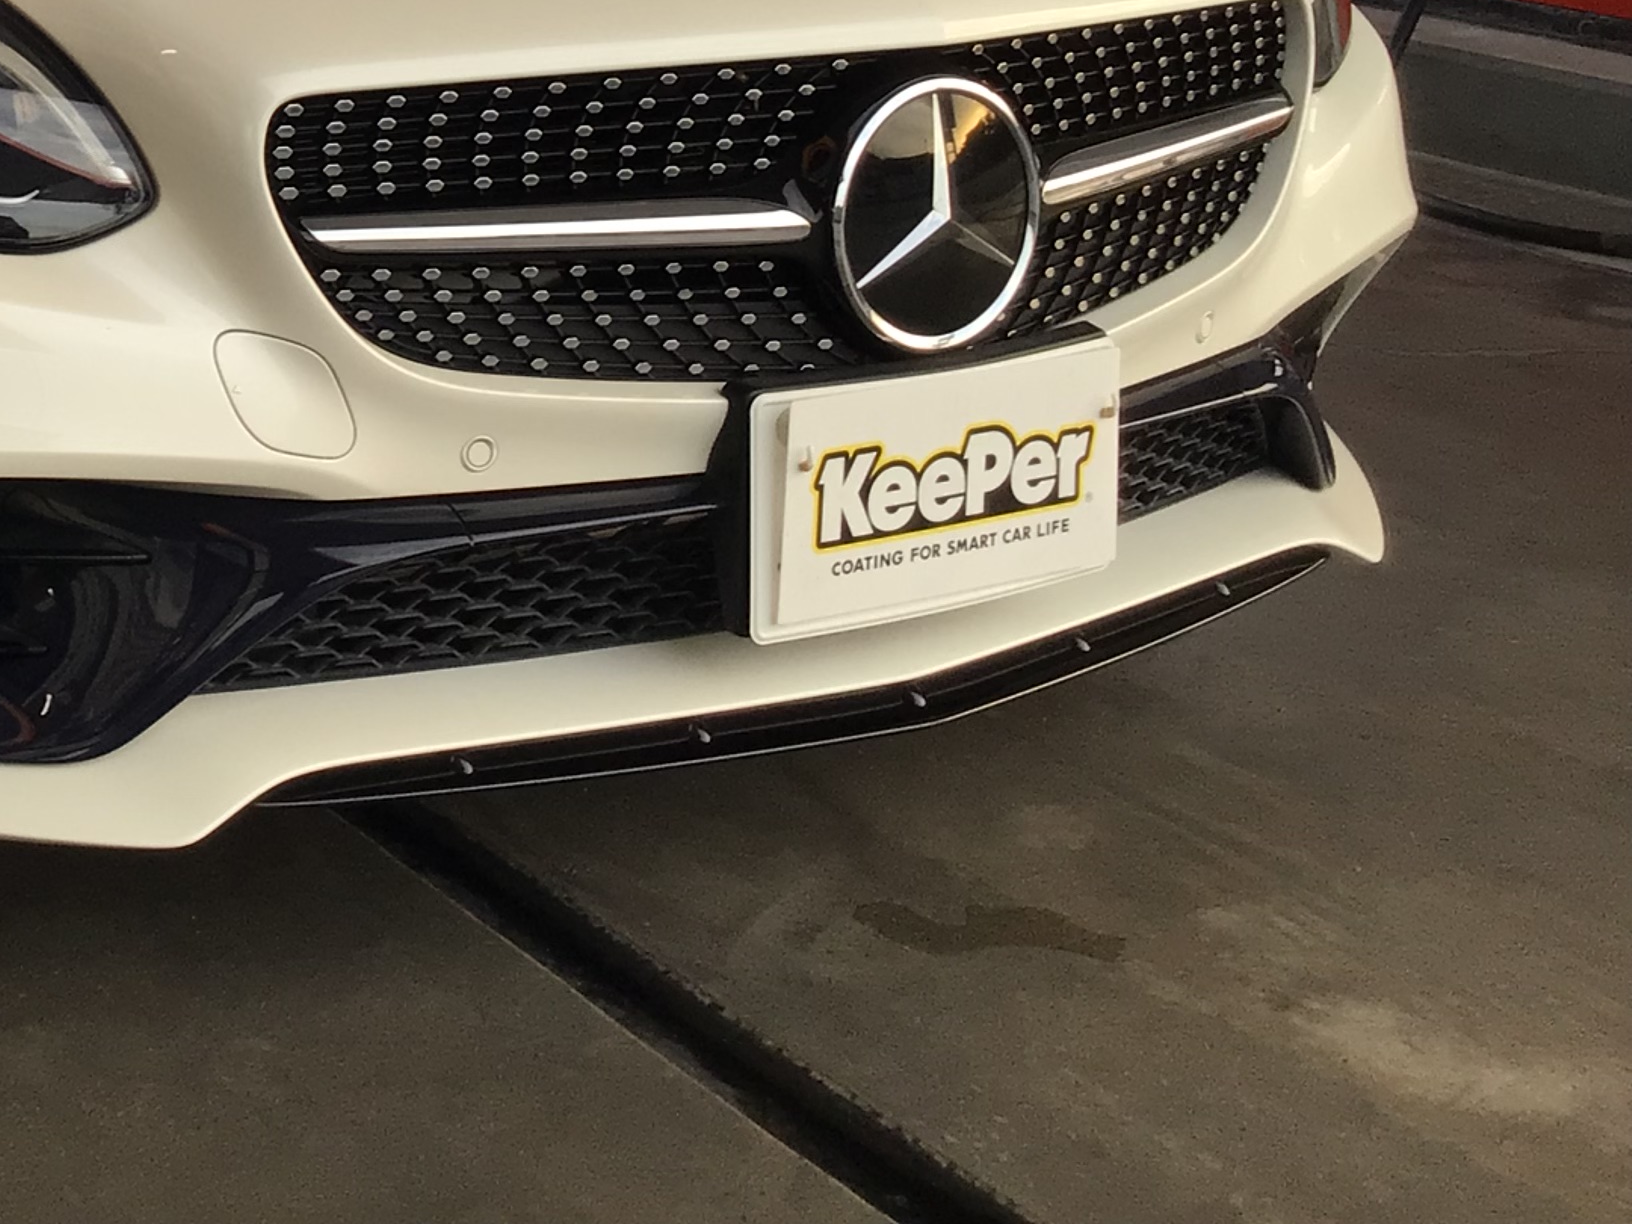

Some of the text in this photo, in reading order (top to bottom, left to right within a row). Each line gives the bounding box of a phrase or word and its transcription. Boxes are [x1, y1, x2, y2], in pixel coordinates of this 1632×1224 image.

[815, 423, 1094, 548] KeePer
[831, 518, 1070, 577] COATING FOR SMART CAR LIFE
